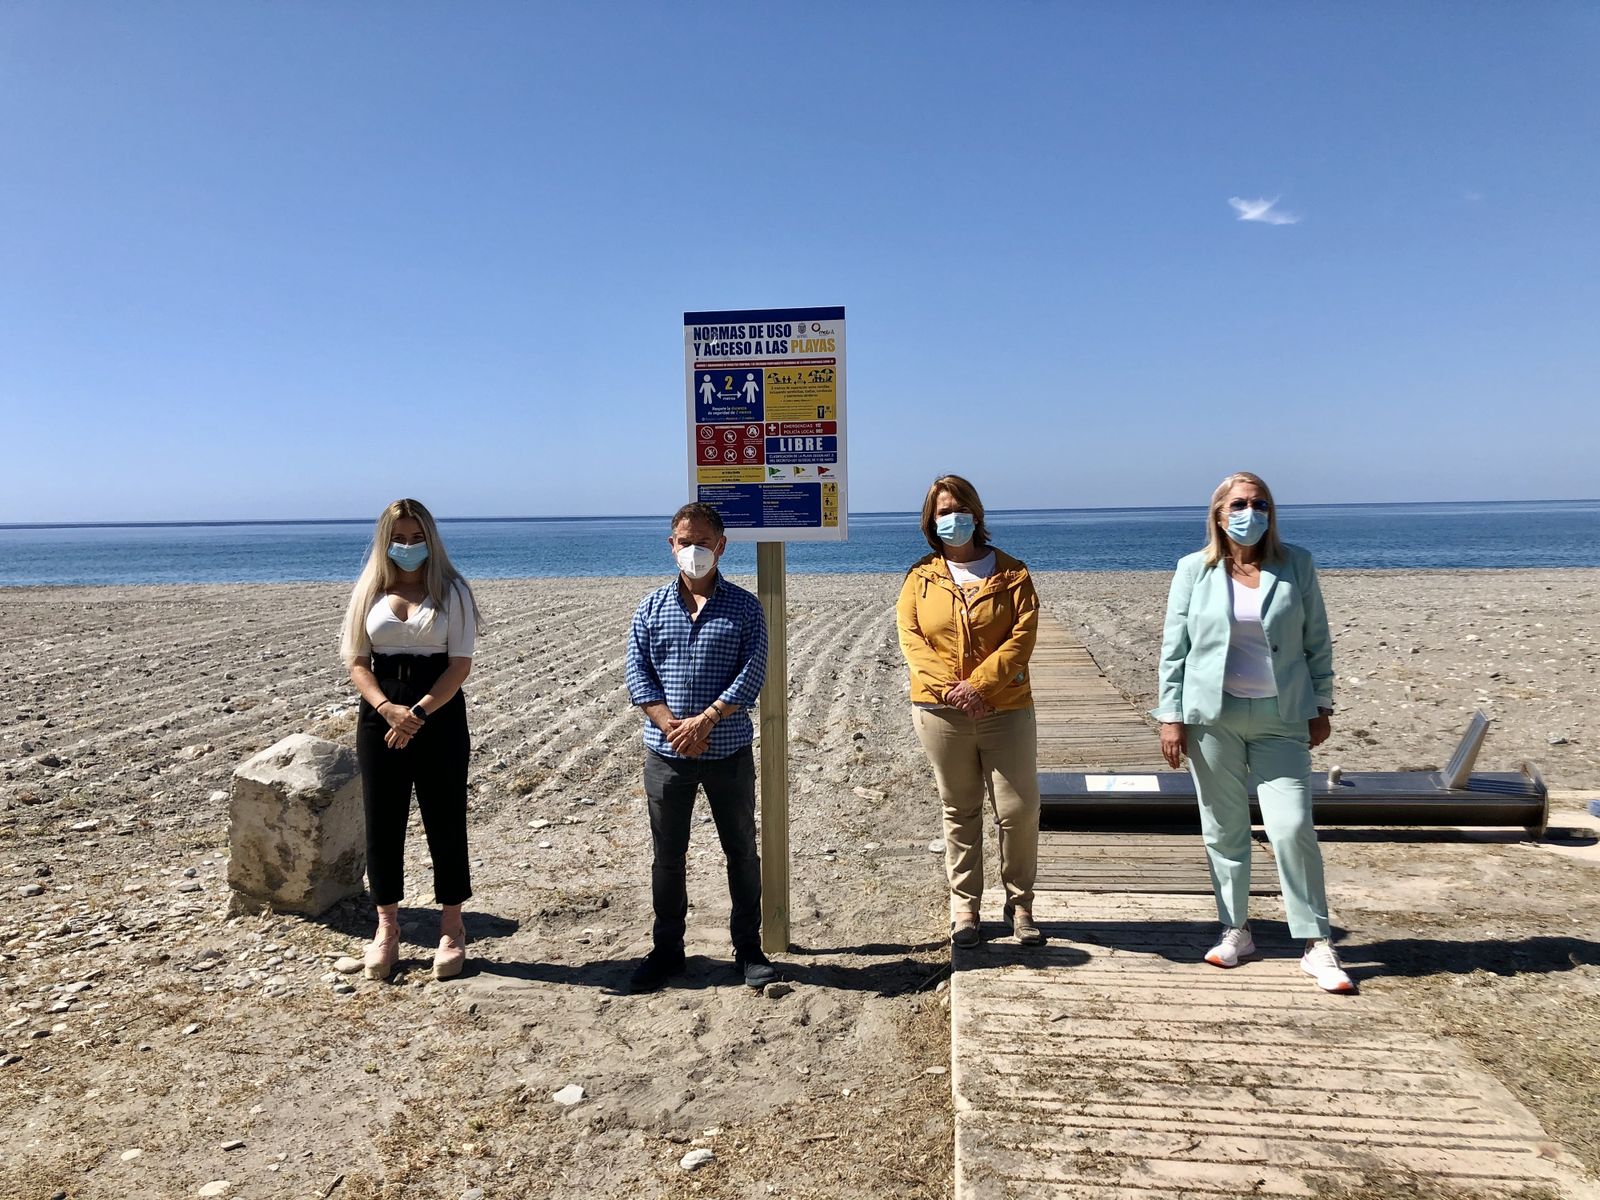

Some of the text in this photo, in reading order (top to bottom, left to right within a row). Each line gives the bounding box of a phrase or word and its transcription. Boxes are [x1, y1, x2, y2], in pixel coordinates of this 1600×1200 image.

[694, 324, 792, 340] NORMAS DE USO
[694, 338, 835, 356] Y ACCESO A LAS PLAYAS
[725, 376, 733, 390] 2
[780, 438, 823, 451] LIBRE
